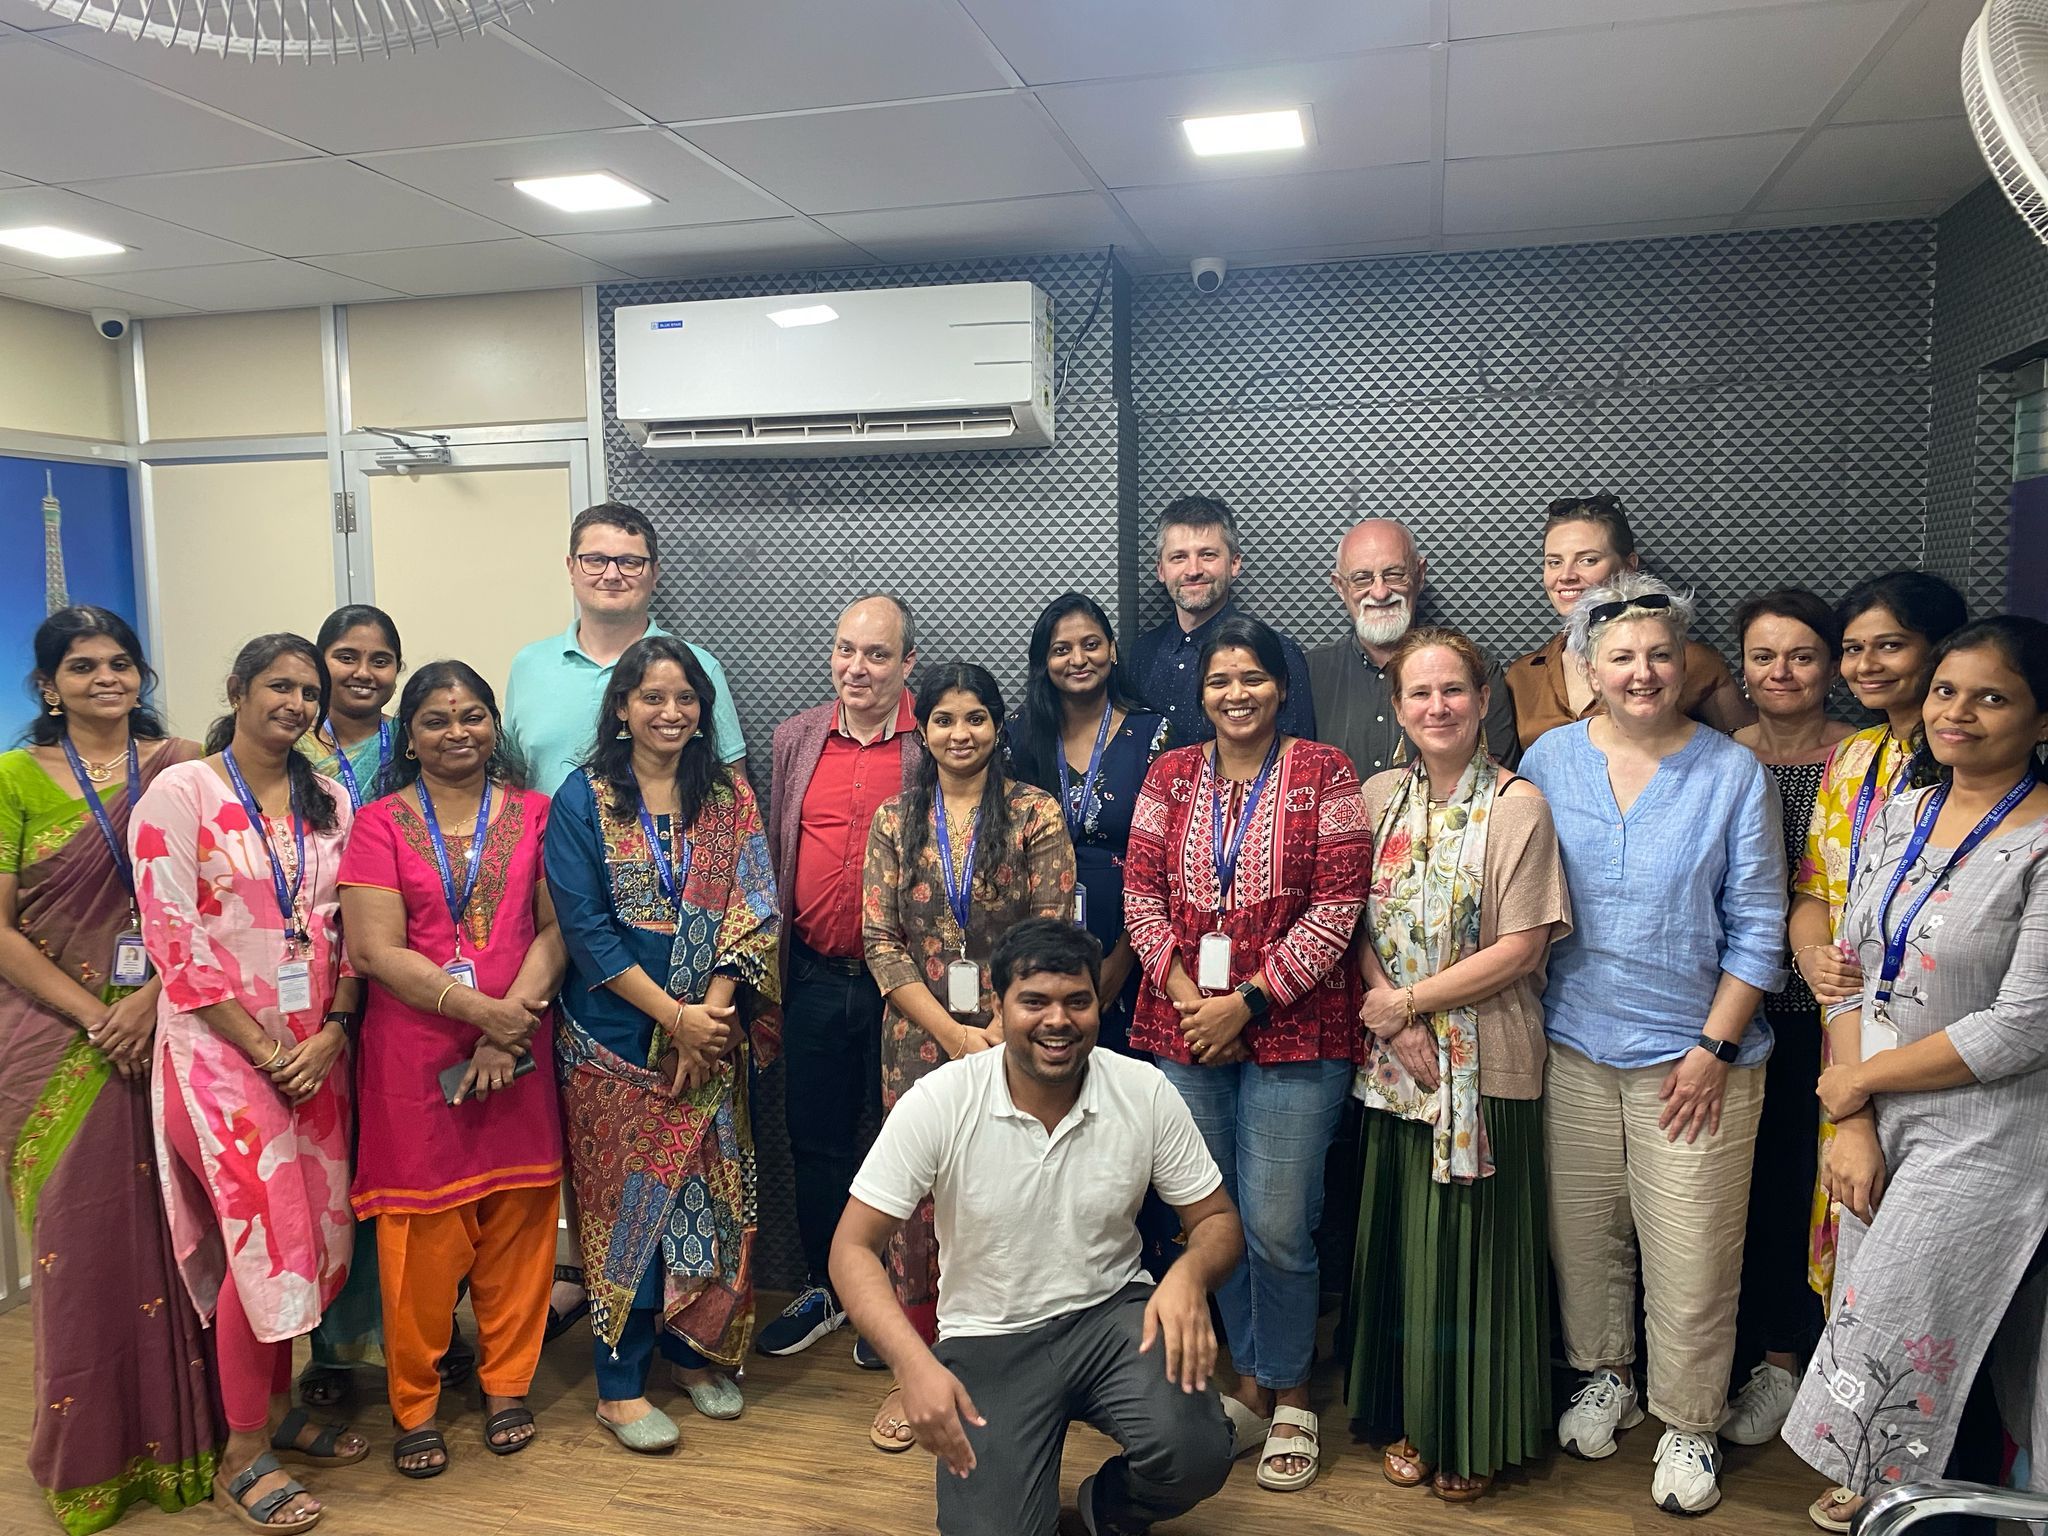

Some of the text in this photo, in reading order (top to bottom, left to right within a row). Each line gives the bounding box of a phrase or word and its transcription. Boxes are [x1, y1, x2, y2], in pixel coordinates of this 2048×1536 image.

[1855, 806, 1863, 826] CENTRE
[1920, 804, 1935, 828] EUROPE
[1973, 813, 1994, 835] EUROPE
[1991, 798, 2008, 816] STUDY
[2006, 781, 2027, 801] CENTRE
